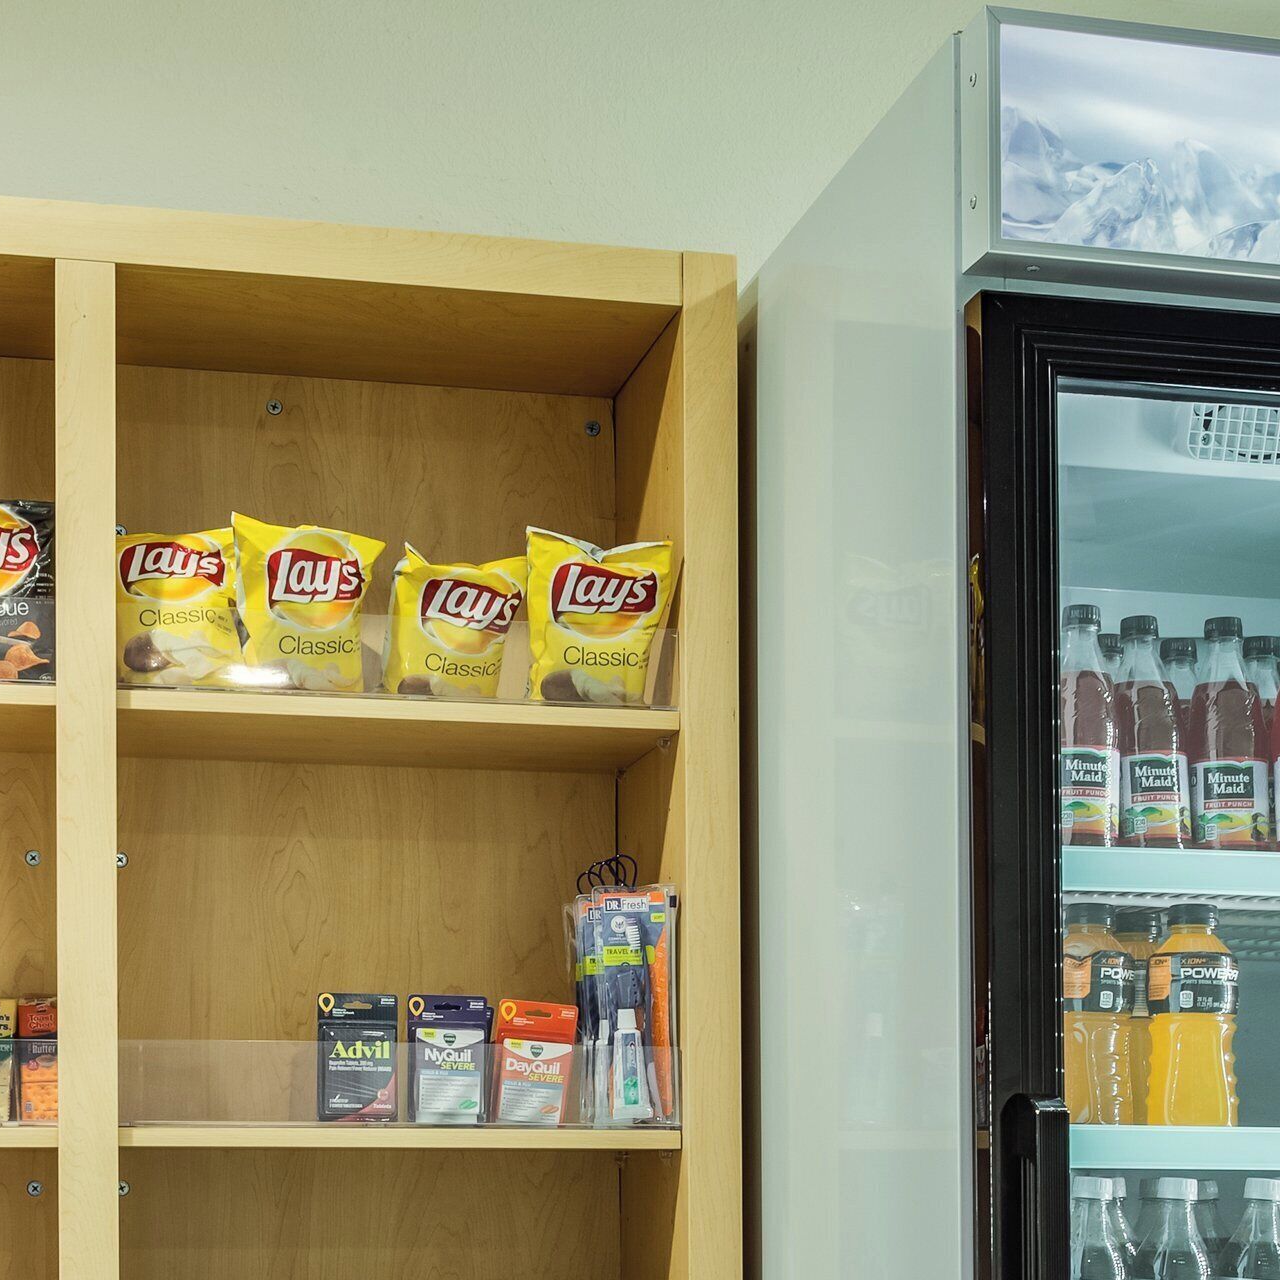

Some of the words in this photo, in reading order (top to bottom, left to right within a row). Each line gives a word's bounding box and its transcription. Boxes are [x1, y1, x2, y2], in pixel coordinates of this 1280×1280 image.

[128, 545, 220, 582] Lay's
[272, 552, 361, 602] Lay's
[557, 566, 654, 613] Lay's
[426, 581, 519, 629] Lay's
[139, 607, 216, 627] Classic
[279, 635, 354, 655] Classic
[425, 652, 496, 677] Classic
[564, 646, 638, 667] Classic
[1066, 758, 1107, 771] Minute
[1135, 766, 1176, 778] Minute
[1071, 769, 1103, 782] Maid
[1141, 776, 1172, 787] Maid
[1208, 773, 1249, 785] Minute
[1213, 783, 1245, 794] Maid
[621, 899, 647, 910] Fresh
[29, 1015, 53, 1023] Toast
[329, 1040, 390, 1059] Advil
[425, 1048, 471, 1064] NyQuil
[506, 1059, 560, 1076] DayQuil
[529, 1073, 563, 1083] SEVERE
